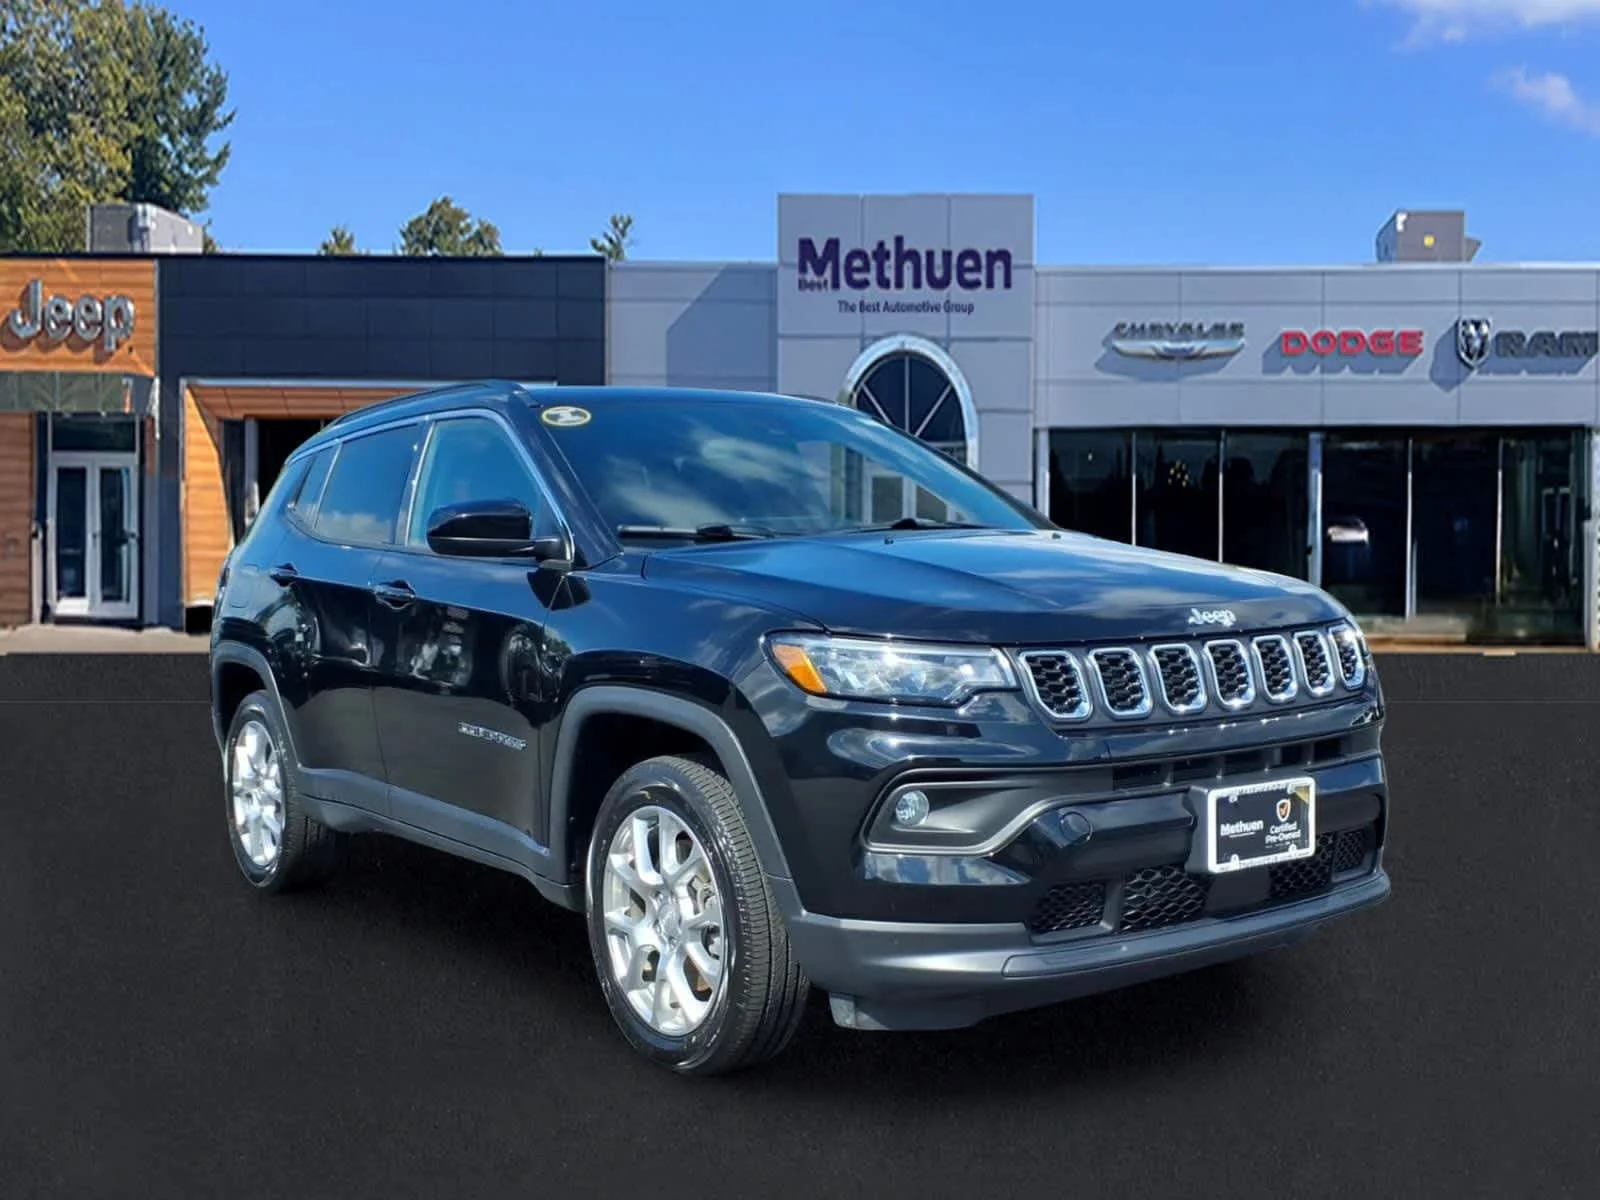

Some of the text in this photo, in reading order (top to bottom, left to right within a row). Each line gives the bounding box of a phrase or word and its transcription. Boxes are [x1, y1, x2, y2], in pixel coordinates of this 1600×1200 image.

[798, 235, 1013, 290] Methuen
[9, 279, 135, 350] Jeep
[838, 300, 975, 315] The Best Automotive Group
[1281, 330, 1424, 356] DODGE
[1496, 331, 1599, 357] RAM
[1188, 608, 1236, 627] Jeep
[1220, 820, 1264, 836] Methuen
